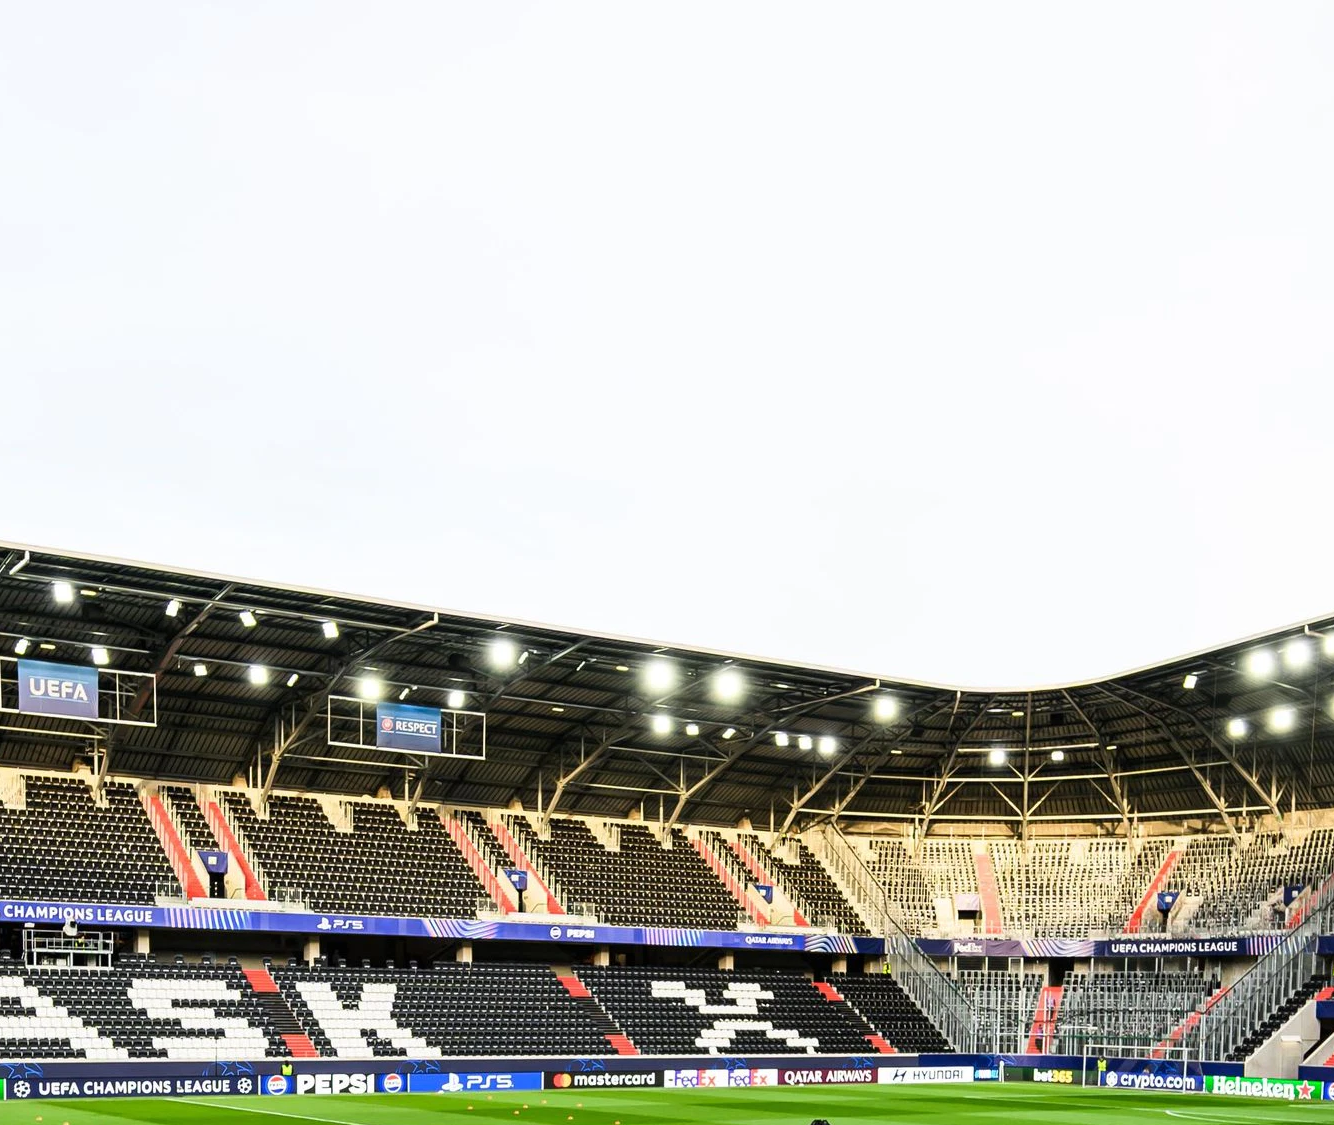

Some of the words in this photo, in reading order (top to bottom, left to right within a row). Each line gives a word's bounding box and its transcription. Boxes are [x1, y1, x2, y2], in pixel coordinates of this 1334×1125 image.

[29, 677, 88, 701] UEFA
[395, 720, 437, 735] RESPECT
[4, 904, 94, 921] CHAMPIONS
[97, 908, 153, 923] LEAGUE
[1111, 943, 1138, 953] UEFA
[1139, 942, 1197, 953] CHAMPIONS
[1199, 941, 1238, 952] LEAGUE
[574, 1072, 655, 1088] mastercard
[675, 1069, 715, 1087] FedEx
[727, 1069, 767, 1086] FedEx
[784, 1070, 824, 1085] QATAR
[826, 1069, 872, 1083] AIRWAYS
[912, 1069, 963, 1080] HYUNDAI
[1033, 1068, 1073, 1083] bet365
[1120, 1072, 1195, 1090] crypto.com
[38, 1081, 80, 1096] UEFA
[83, 1079, 173, 1095] CHAMPIONS
[176, 1078, 231, 1094] LEAGUE
[296, 1073, 375, 1094] PEPSI
[1212, 1076, 1295, 1100] Heineken
